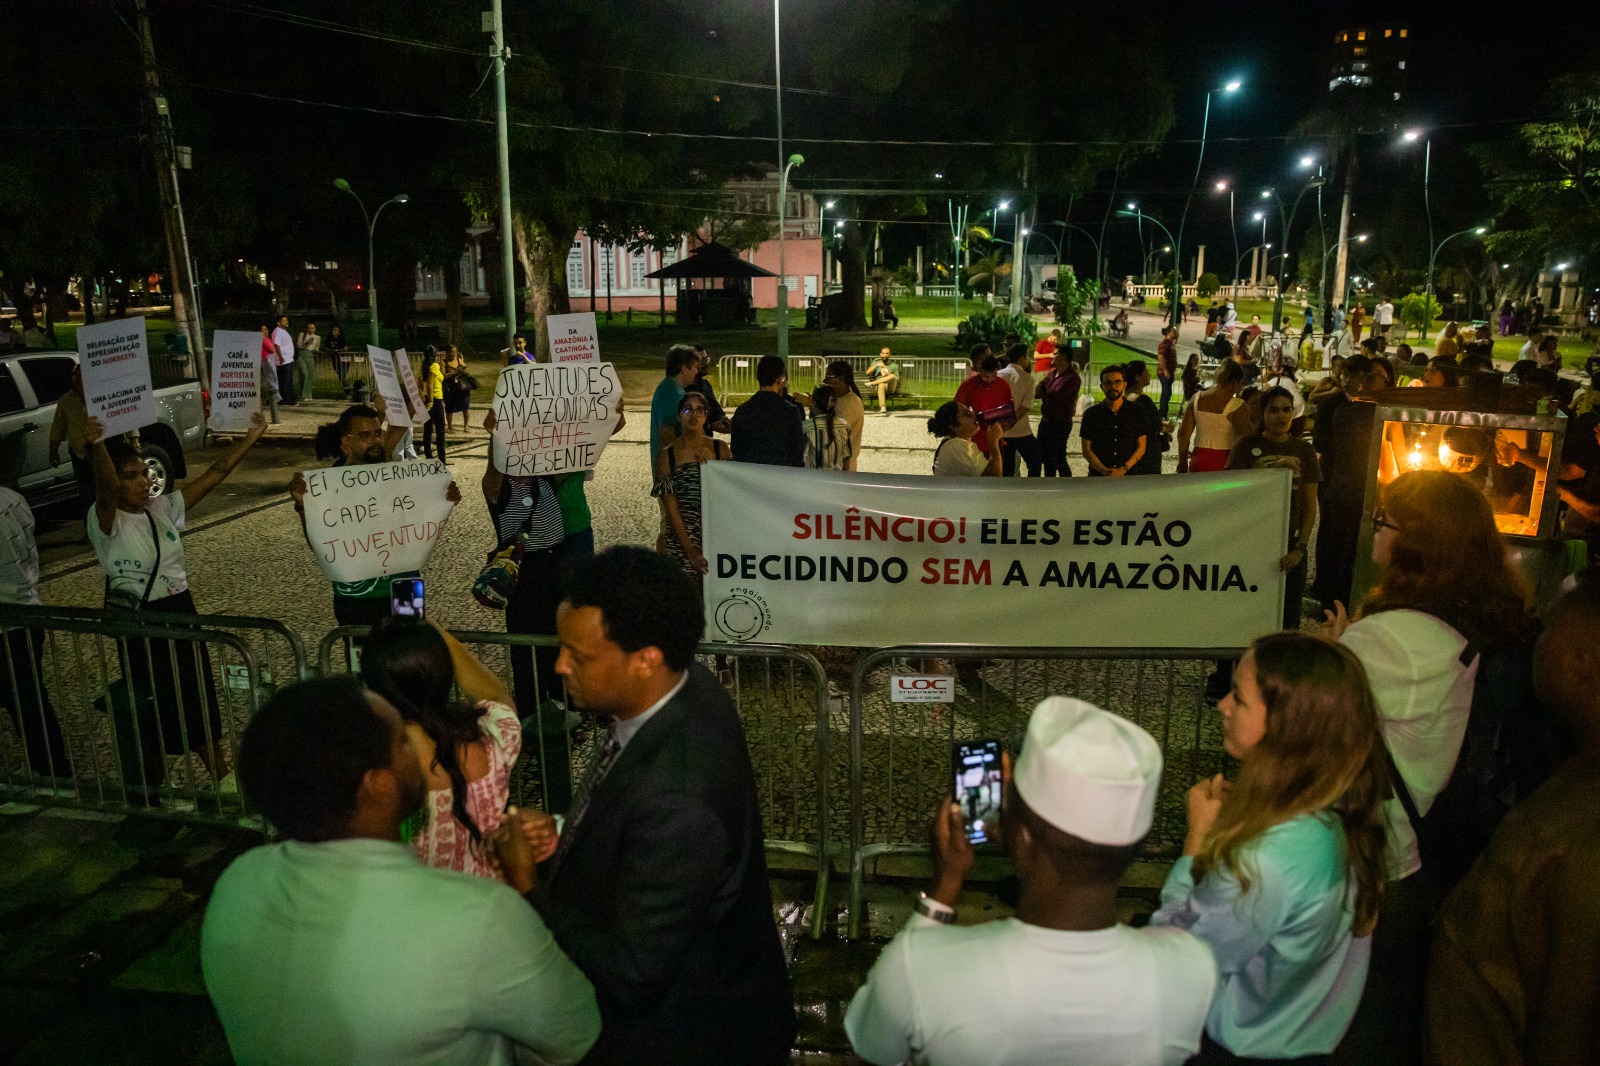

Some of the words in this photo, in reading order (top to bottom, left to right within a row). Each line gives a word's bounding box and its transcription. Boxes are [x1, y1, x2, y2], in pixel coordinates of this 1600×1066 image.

[86, 335, 125, 350] DELEGAÇÃO
[126, 333, 140, 343] SEM
[554, 335, 589, 345] AMAZÔNIA
[87, 341, 141, 359] REPRESENTAÇÃO
[227, 350, 243, 359] CADÊ
[243, 351, 249, 359] A
[559, 352, 594, 362] JUVENTUDE
[91, 359, 102, 368] DO
[221, 361, 254, 370] JUVENTUDE
[220, 371, 250, 379] NORTISTA
[249, 371, 254, 379] E
[495, 364, 614, 399] JUVENTUDES
[218, 381, 255, 389] NORDESTINA
[91, 394, 107, 405] UMA
[107, 387, 134, 400] LACUNA
[134, 384, 147, 395] QUE
[101, 403, 107, 412] A
[107, 394, 142, 410] JUVENTUDE
[216, 391, 229, 400] QUE
[229, 391, 257, 399] ESTAVAM
[106, 404, 140, 419] CONTESTE.
[506, 421, 592, 455] AUSENTE
[505, 442, 597, 476] PRESENTE
[322, 496, 380, 528] CADÊ
[392, 495, 416, 513] AS
[792, 506, 967, 544] SILÊNCIO!
[980, 518, 1061, 546] ELES
[1072, 512, 1192, 548] ESTÃO
[377, 549, 390, 575] ?
[716, 553, 909, 584] DECIDINDO
[920, 557, 992, 586] SEM
[1002, 559, 1029, 587] A
[1039, 553, 1259, 593] AMAZÔNIA.
[729, 587, 773, 631] engajamundo
[898, 679, 947, 690] LOC
